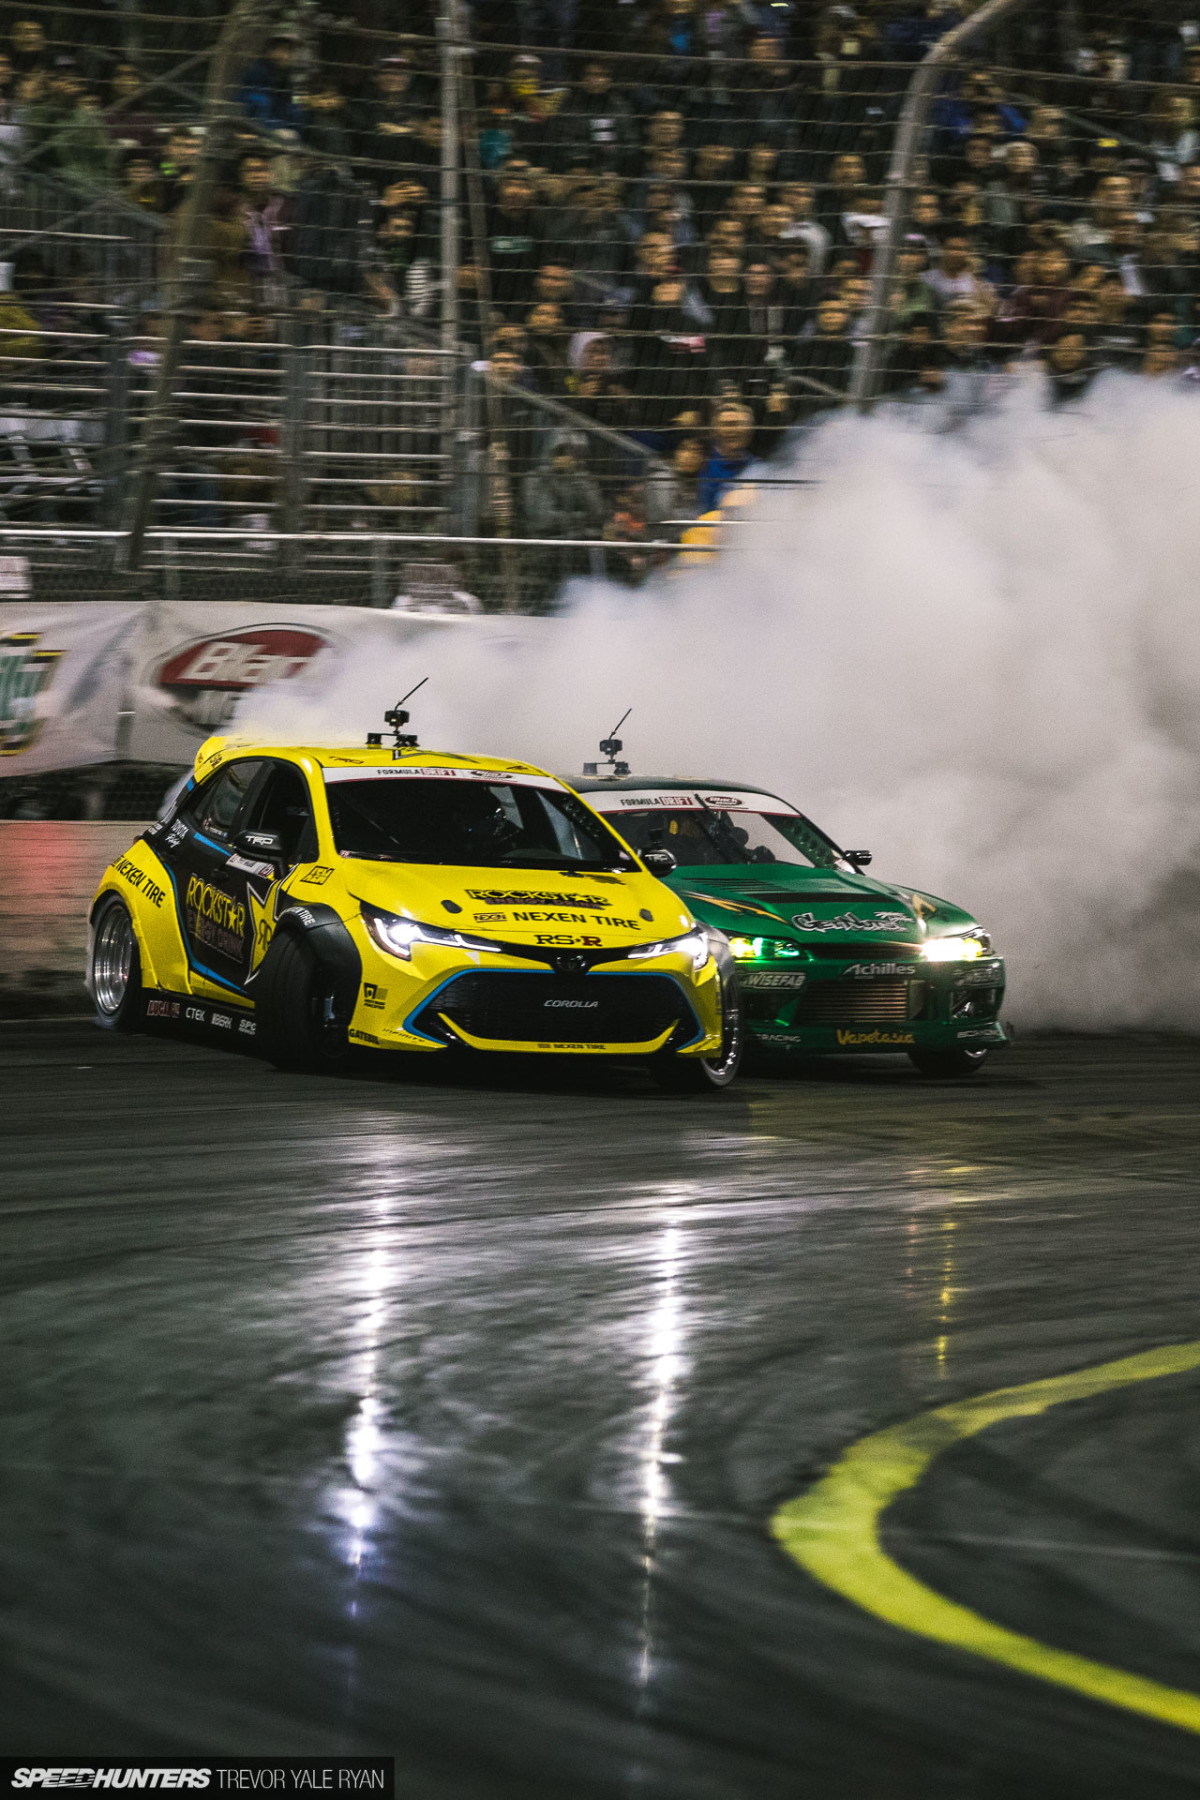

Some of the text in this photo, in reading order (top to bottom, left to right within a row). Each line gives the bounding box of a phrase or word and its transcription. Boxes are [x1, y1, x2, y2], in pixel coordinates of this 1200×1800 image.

[660, 796, 693, 805] DRIFT
[245, 835, 273, 845] TRD
[116, 859, 147, 888] NEXEN
[142, 879, 166, 909] TIRE
[297, 908, 316, 926] TIRE
[512, 912, 641, 930] NEXEN TIRE
[842, 963, 916, 977] Achilles
[746, 974, 805, 987] WISEFAB
[544, 1000, 598, 1008] COROLLA
[186, 1007, 206, 1022] CTEK
[837, 1028, 915, 1045] Vapetasia
